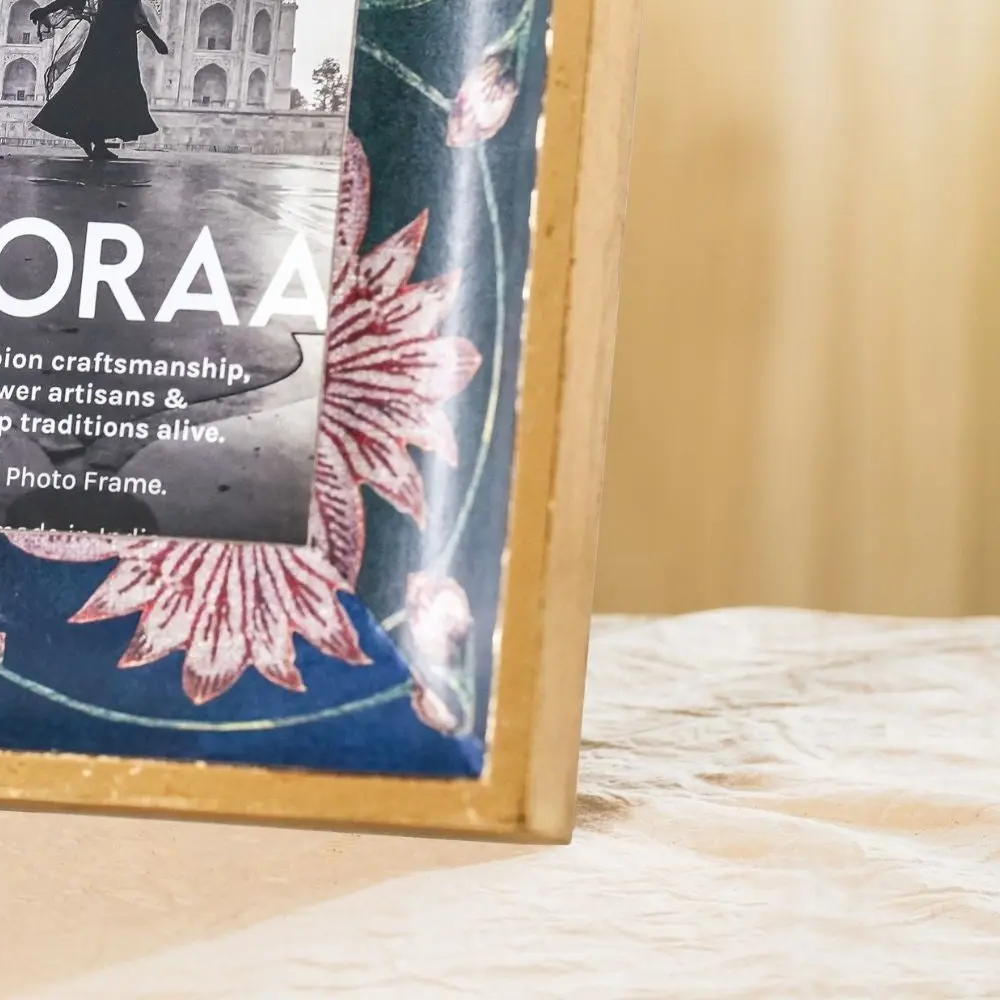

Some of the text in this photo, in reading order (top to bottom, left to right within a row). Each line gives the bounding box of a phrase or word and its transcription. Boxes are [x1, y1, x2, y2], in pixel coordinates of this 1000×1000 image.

[51, 352, 250, 385] craftsmanship,
[48, 382, 156, 408] artisans
[164, 388, 188, 409] &
[20, 412, 149, 439] traditions
[156, 419, 226, 444] alive.
[6, 466, 76, 490] Photo
[84, 471, 167, 495] Frame.
